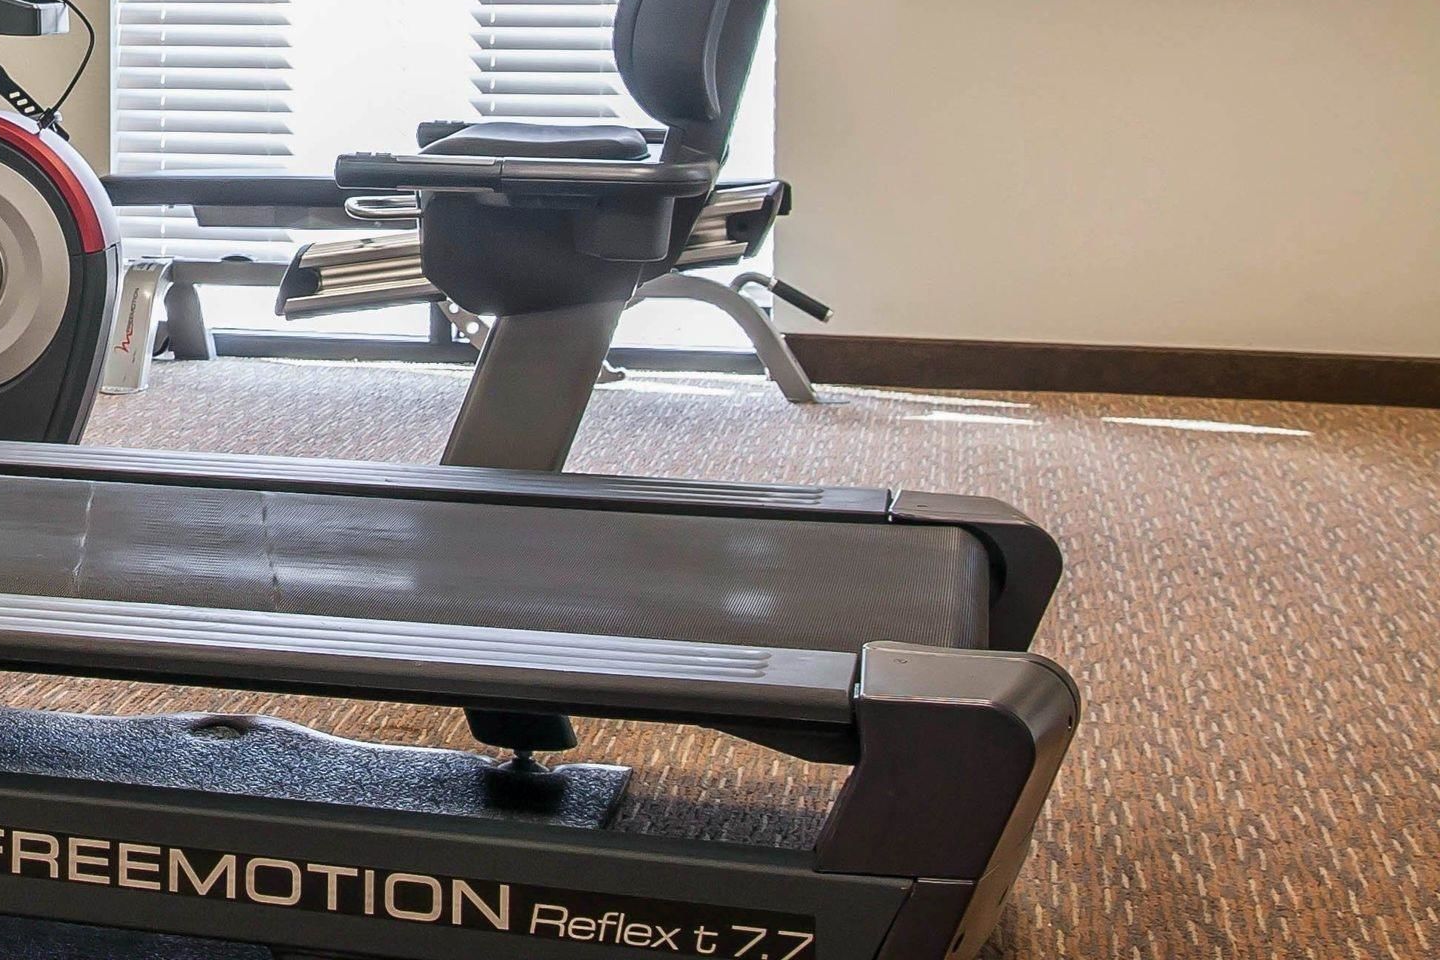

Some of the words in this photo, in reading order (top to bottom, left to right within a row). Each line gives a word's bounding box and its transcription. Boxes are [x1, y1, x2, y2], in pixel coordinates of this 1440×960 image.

[528, 902, 682, 951] Reflex
[693, 925, 719, 954] t
[730, 924, 814, 960] 7.7
